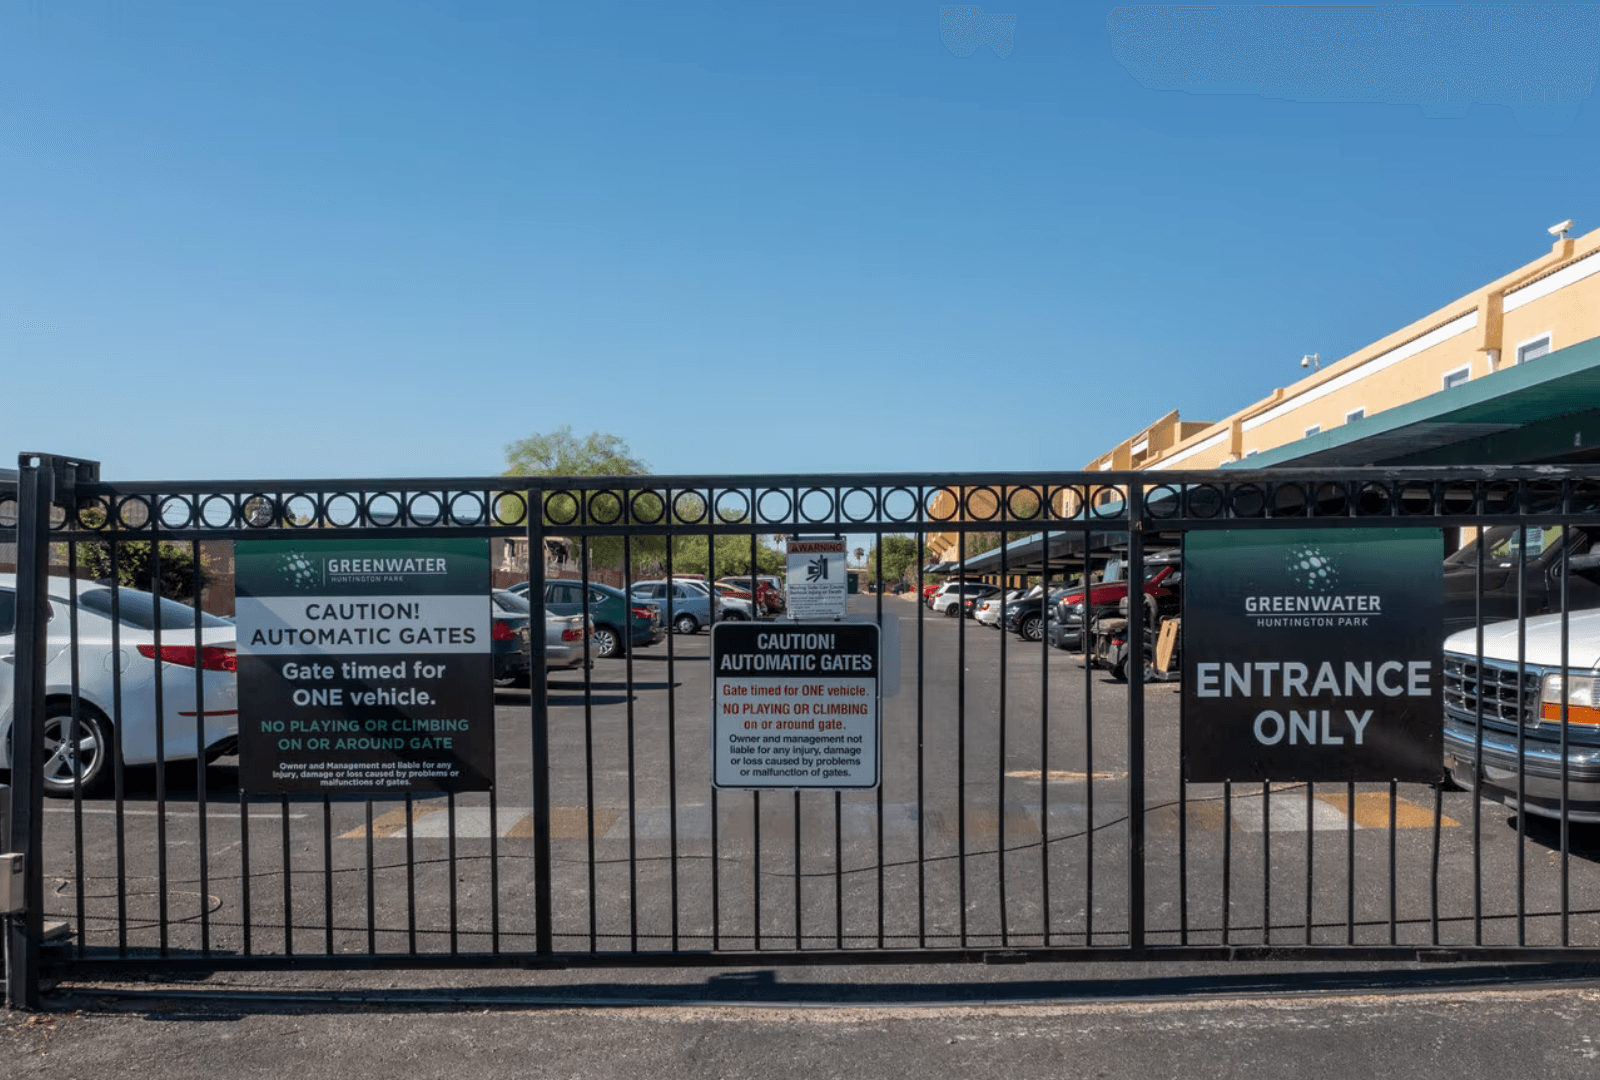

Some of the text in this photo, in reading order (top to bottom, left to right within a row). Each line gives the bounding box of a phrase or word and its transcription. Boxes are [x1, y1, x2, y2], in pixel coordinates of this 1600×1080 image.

[799, 543, 843, 552] WARNING
[328, 558, 447, 573] GREENWATER
[331, 575, 404, 583] HUNTINGTON PARK
[1244, 595, 1382, 612] GREENWATER
[305, 603, 420, 620] CAUTION!
[1256, 617, 1369, 627] HUNTINGTON PARK
[250, 627, 476, 646] AUTOMATIC GATES
[757, 633, 836, 650] CAUTION!
[720, 653, 873, 671] AUTOMATIC GATES
[282, 661, 446, 680] Gate timed for
[1196, 660, 1432, 698] ENTRANCE
[292, 687, 436, 706] ONE vehicle.
[723, 684, 870, 696] Gate timed for ONE vehicle.
[723, 703, 868, 715] NO PLAYING OR CLIMBING
[261, 718, 469, 733] NO PLAYING OR CLIMBING
[743, 719, 846, 732] on or around gate.
[1252, 709, 1375, 746] ONLY
[278, 737, 453, 750] ON OR AROUND GATE
[729, 734, 863, 746] Owner and management not
[730, 745, 862, 757] liable for any injury, damage
[279, 762, 307, 770] Owner
[326, 762, 380, 771] Management
[381, 761, 396, 769] not
[397, 761, 421, 769] liable
[422, 761, 434, 769] for
[436, 762, 452, 770] any
[730, 756, 861, 767] or loss caused by problems
[300, 770, 334, 779] damage
[346, 770, 364, 778] loss
[364, 769, 394, 778] caused
[396, 770, 407, 779] by
[408, 769, 449, 779] problems
[740, 767, 852, 778] or malfunction of gates.
[319, 777, 412, 787] malfunctions of gates.
